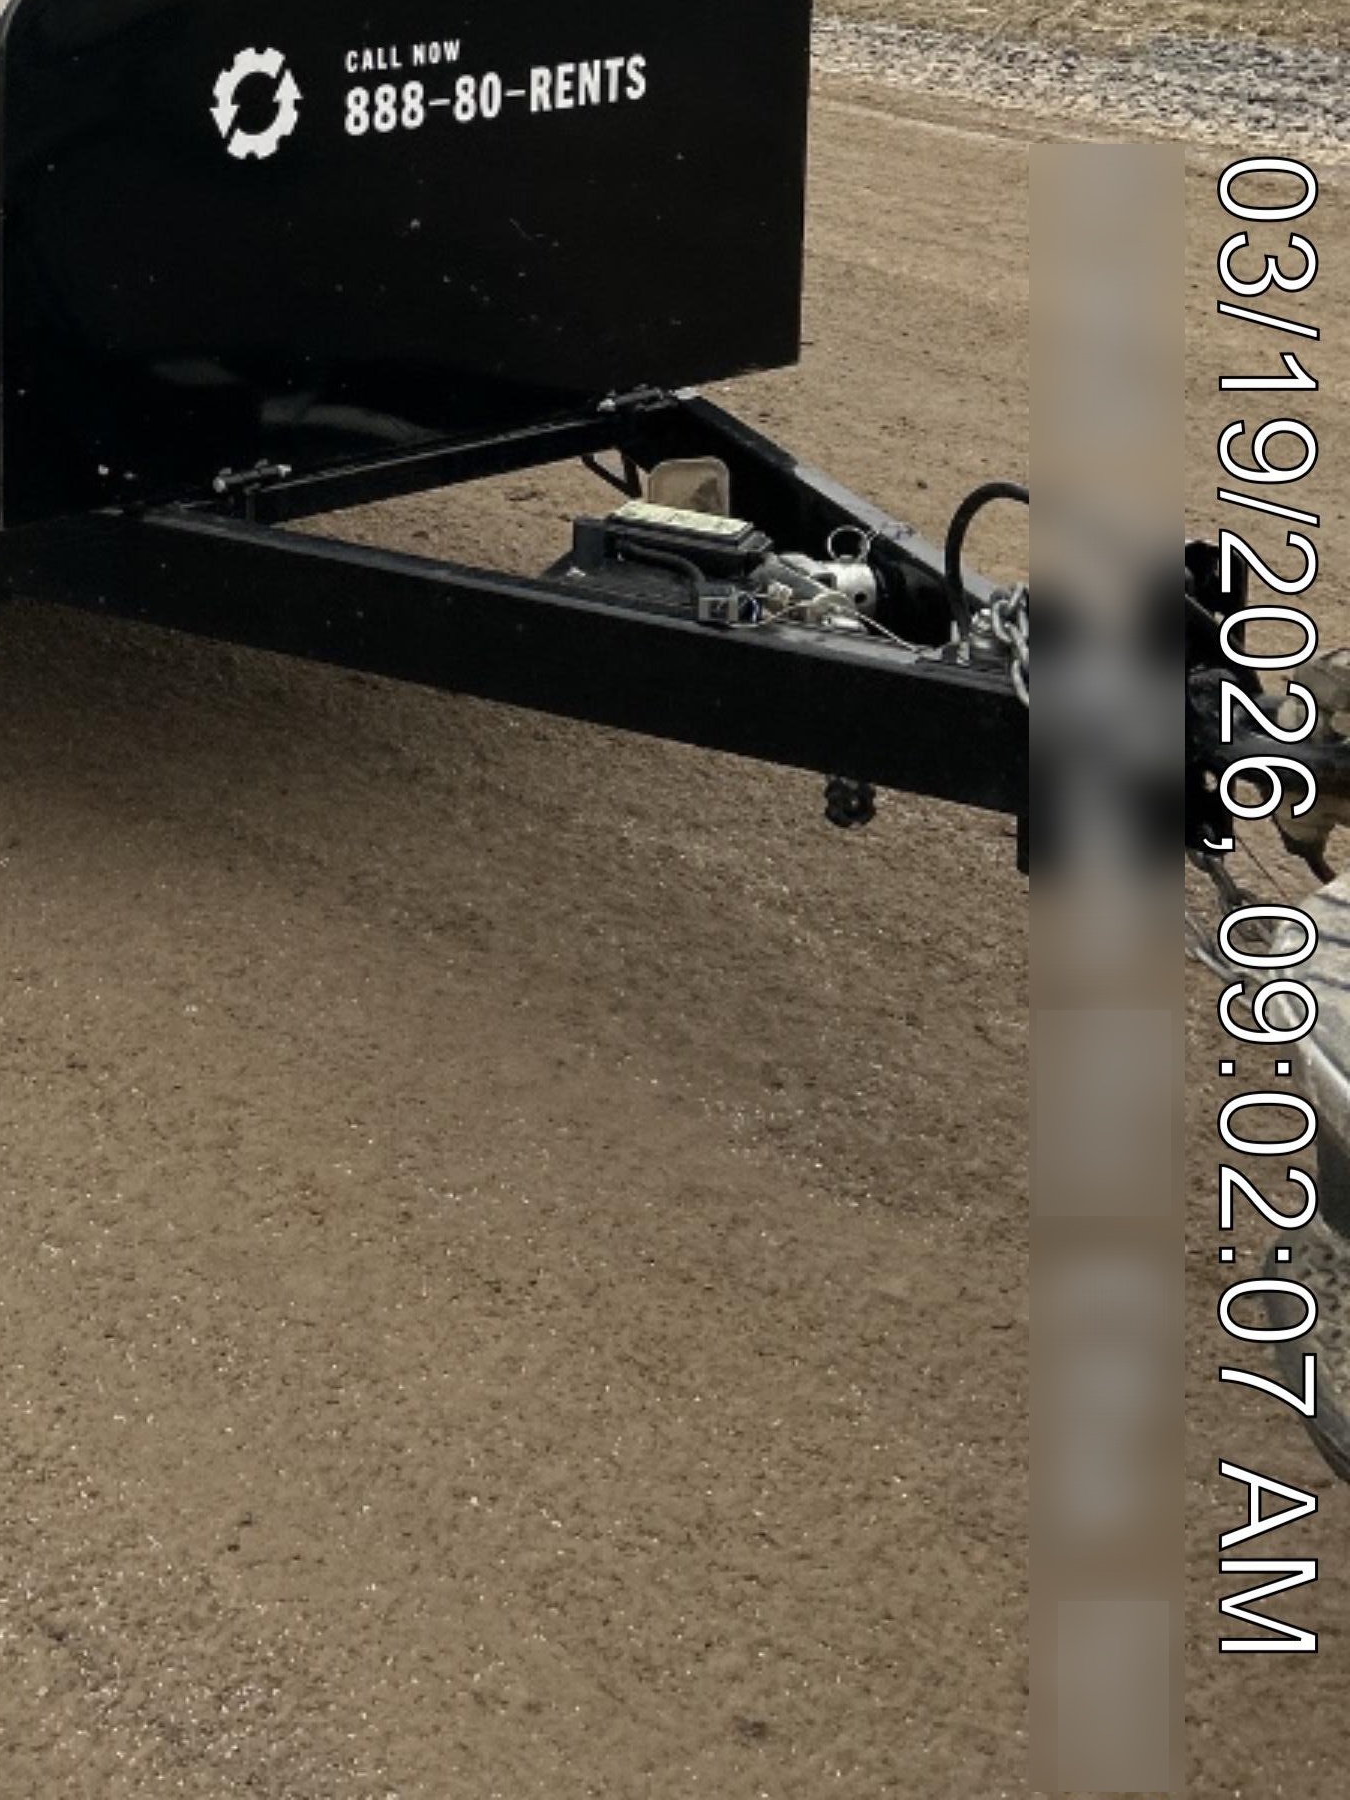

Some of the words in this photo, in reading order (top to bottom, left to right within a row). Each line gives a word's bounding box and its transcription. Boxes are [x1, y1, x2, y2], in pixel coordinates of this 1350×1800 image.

[344, 45, 404, 75] CALL
[412, 38, 461, 68] NOW
[344, 53, 647, 136] 888-80-RENTS
